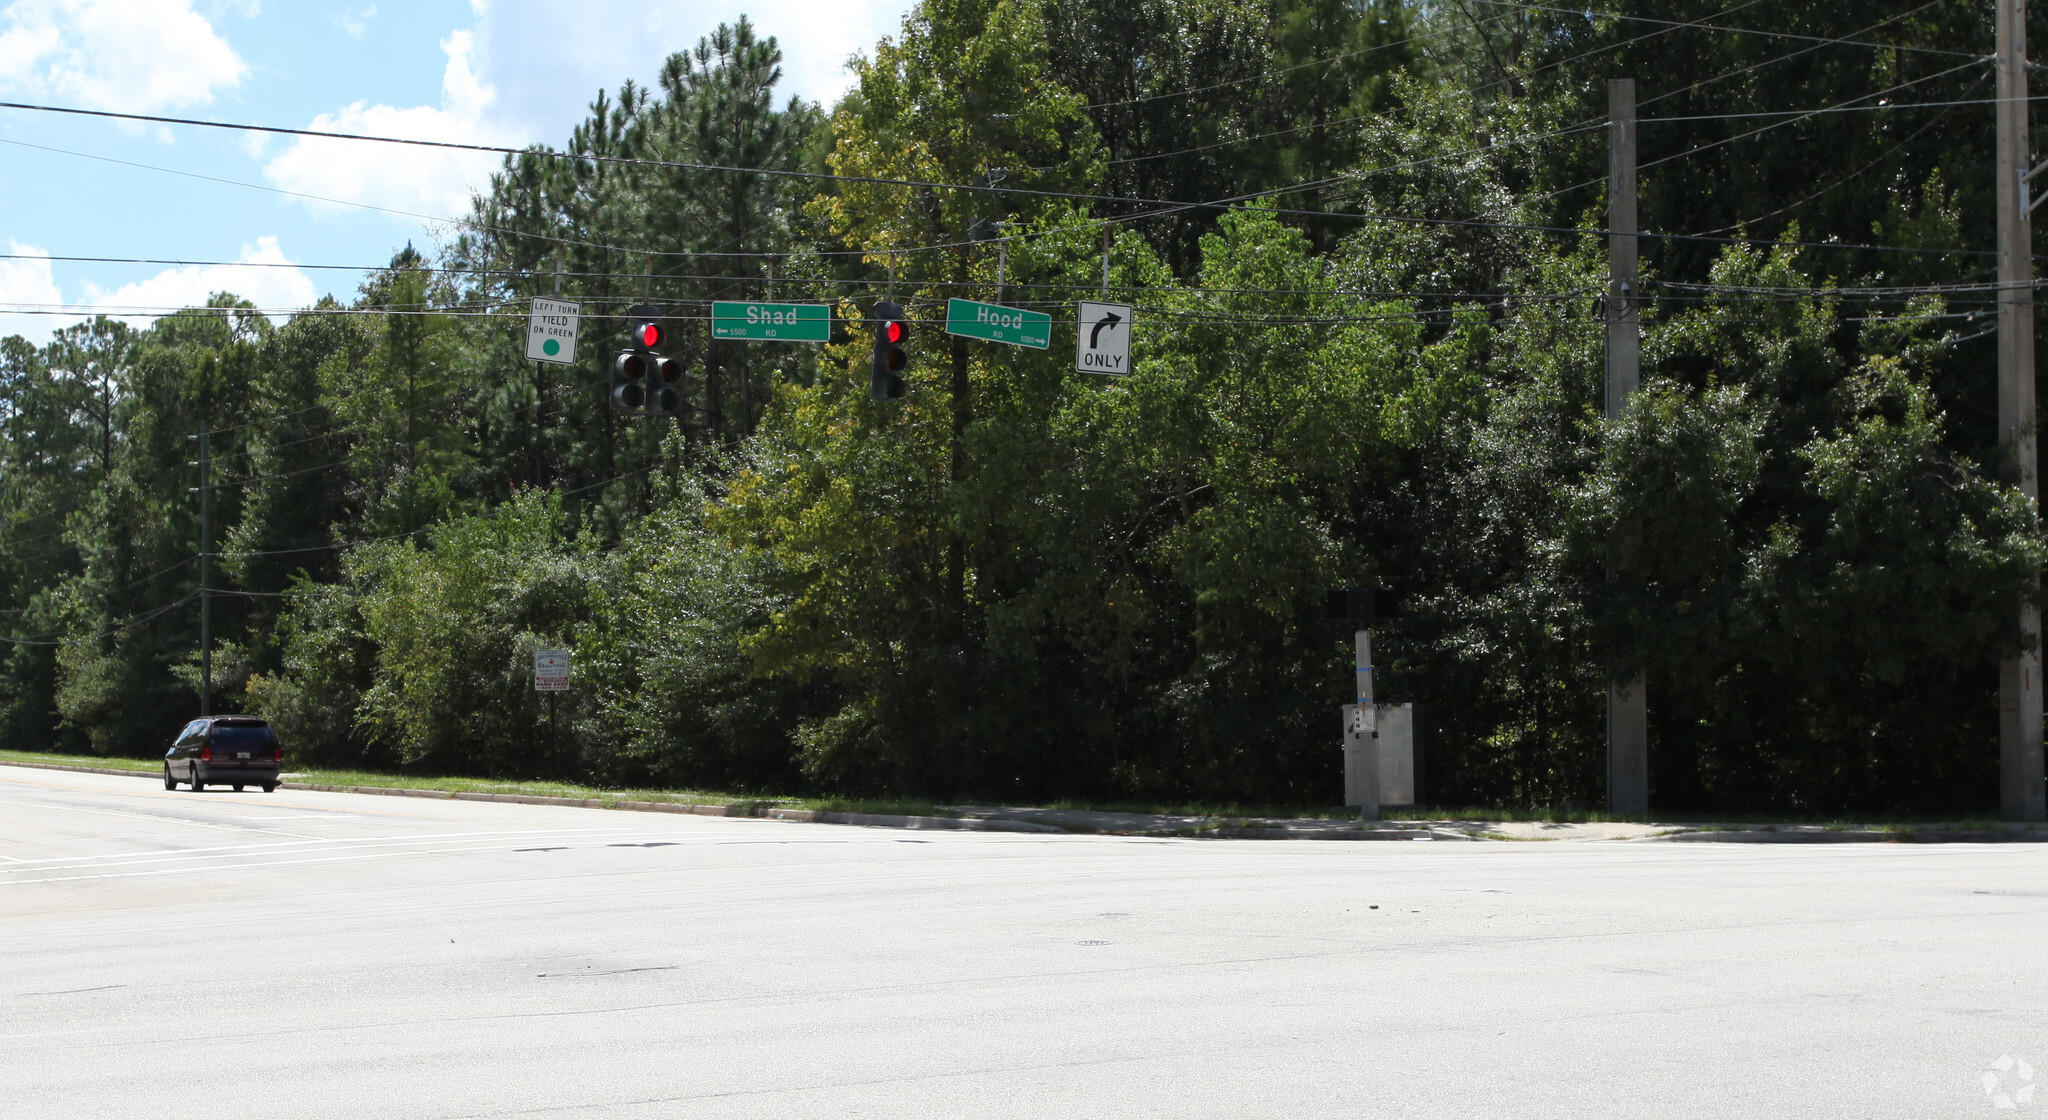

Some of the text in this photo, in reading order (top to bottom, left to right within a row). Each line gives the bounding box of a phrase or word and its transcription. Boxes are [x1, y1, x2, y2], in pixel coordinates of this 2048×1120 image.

[535, 302, 578, 315] LEFT TURN
[542, 314, 568, 326] YIELD
[746, 306, 797, 325] Shad
[977, 306, 1023, 330] Hood
[533, 325, 573, 338] ON GREEN
[730, 328, 747, 336] 5500
[765, 329, 777, 337] RD
[993, 330, 1003, 339] RD
[1084, 353, 1122, 368] ONLY
